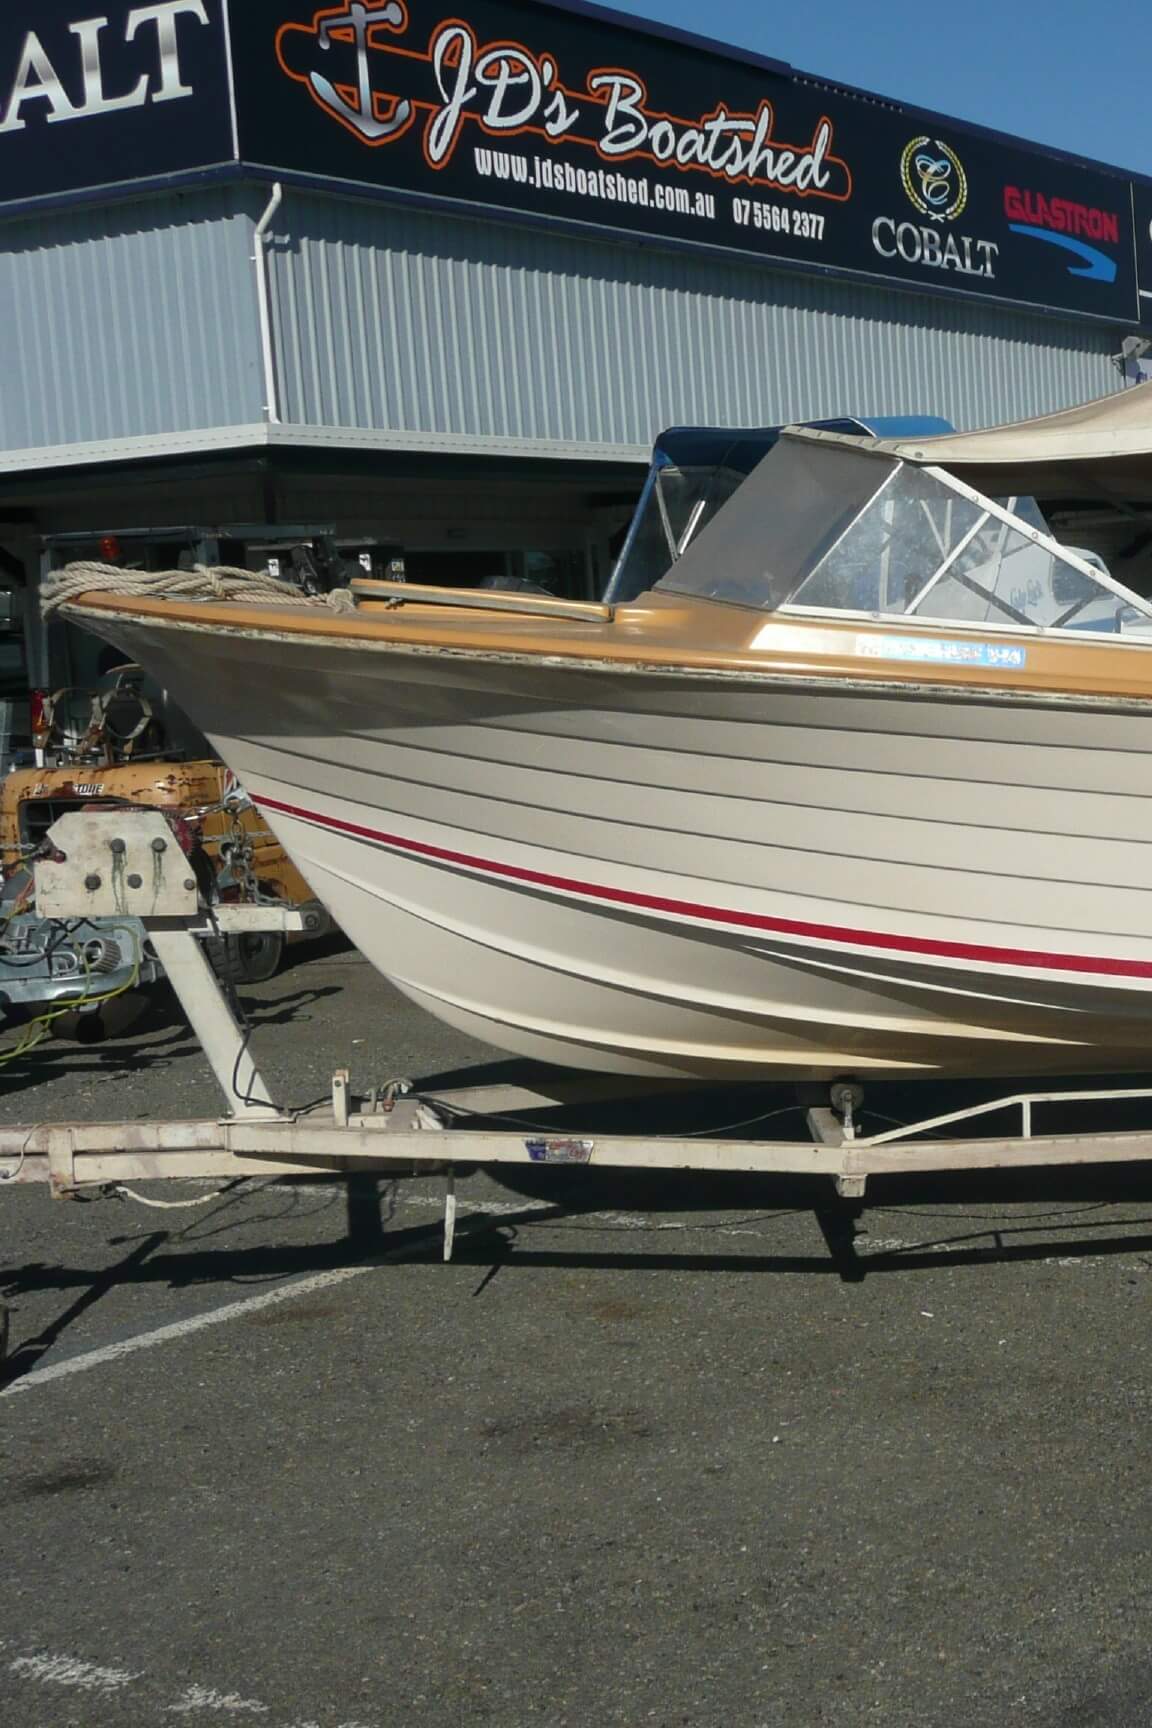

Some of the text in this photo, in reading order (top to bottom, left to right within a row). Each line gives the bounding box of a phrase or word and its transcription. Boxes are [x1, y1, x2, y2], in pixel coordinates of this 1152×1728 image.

[0, 0, 210, 133] ALT
[429, 27, 830, 190] JD's Boatshed
[474, 147, 825, 240] www.jdsboatshed.com.au 07 5564 2377
[1003, 185, 1120, 244] GLASTRON
[871, 216, 999, 279] COBALT
